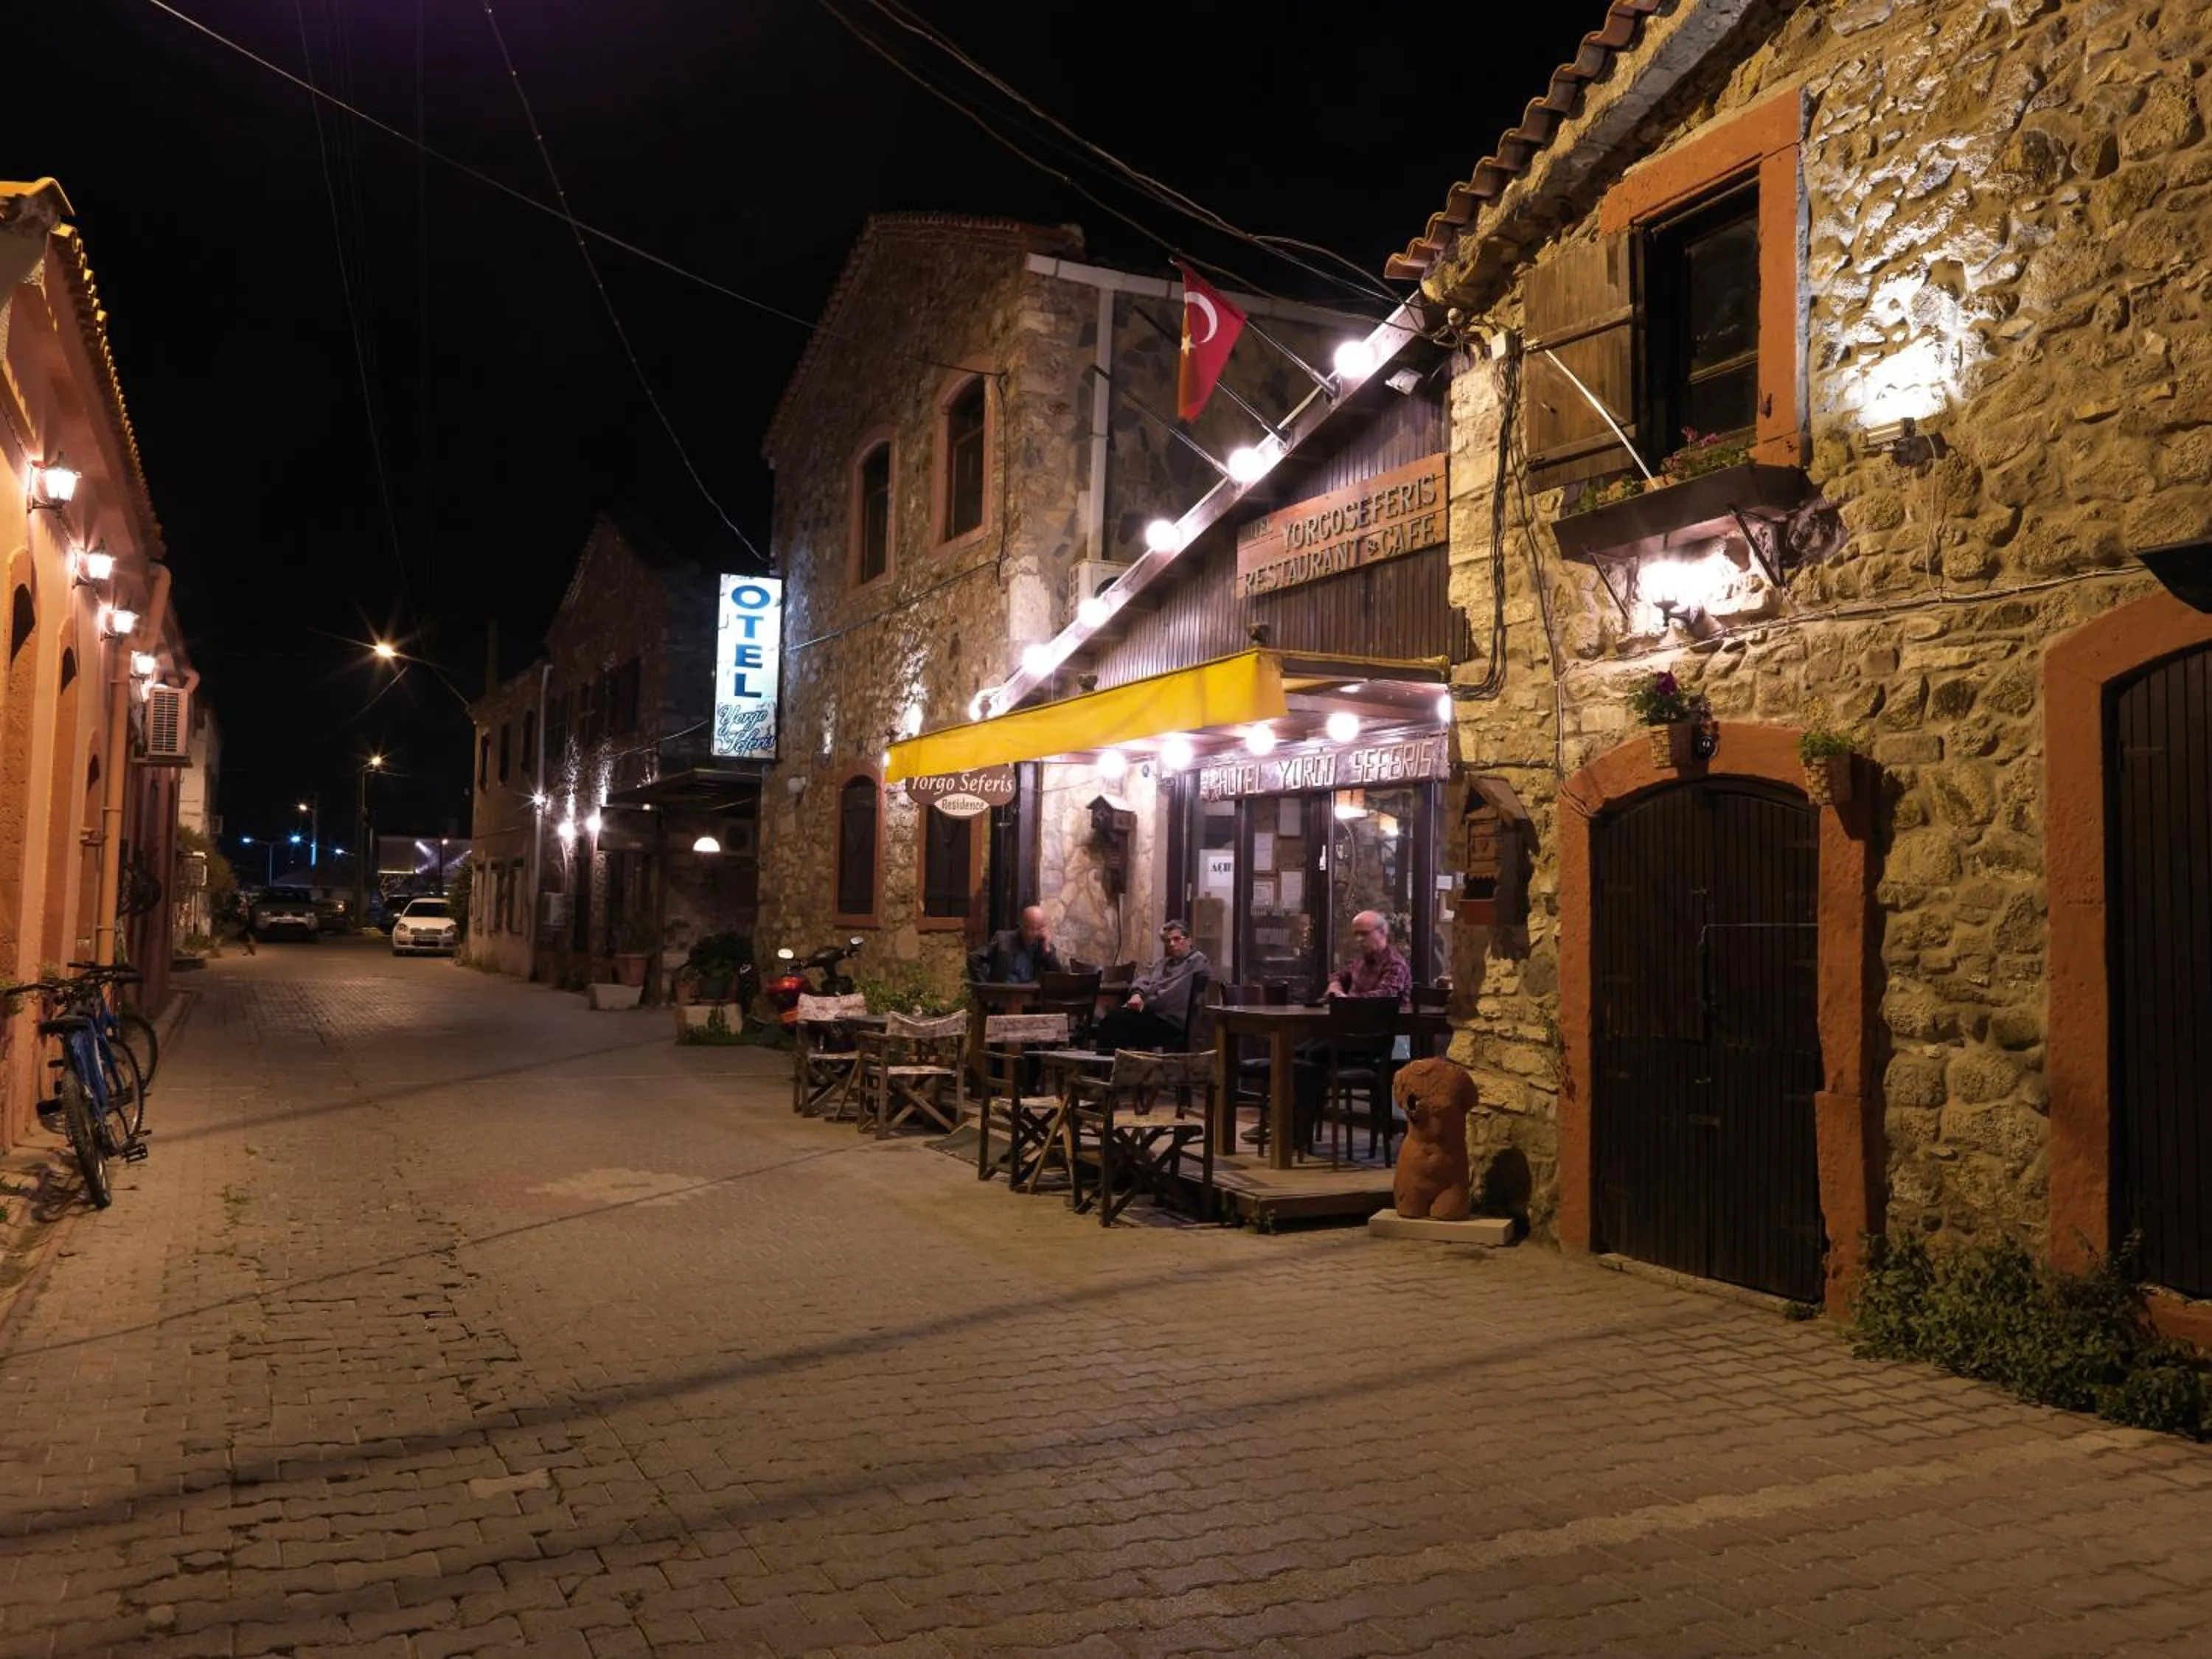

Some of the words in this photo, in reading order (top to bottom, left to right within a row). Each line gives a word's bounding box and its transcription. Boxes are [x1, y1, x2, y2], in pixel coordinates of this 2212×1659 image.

[1245, 538, 1361, 595] RESTAURANT
[1367, 539, 1380, 556] &
[1382, 514, 1436, 557] CAFE
[731, 585, 771, 698] OTEL
[718, 704, 768, 736] Yorgo
[718, 728, 776, 755] Seferis
[1219, 763, 1265, 796] HOTEL
[1274, 754, 1337, 790] YORGO
[1349, 740, 1434, 784] SEFERIS
[912, 776, 955, 796] Yorgo
[959, 773, 1013, 794] Seferis
[942, 797, 984, 811] Residence
